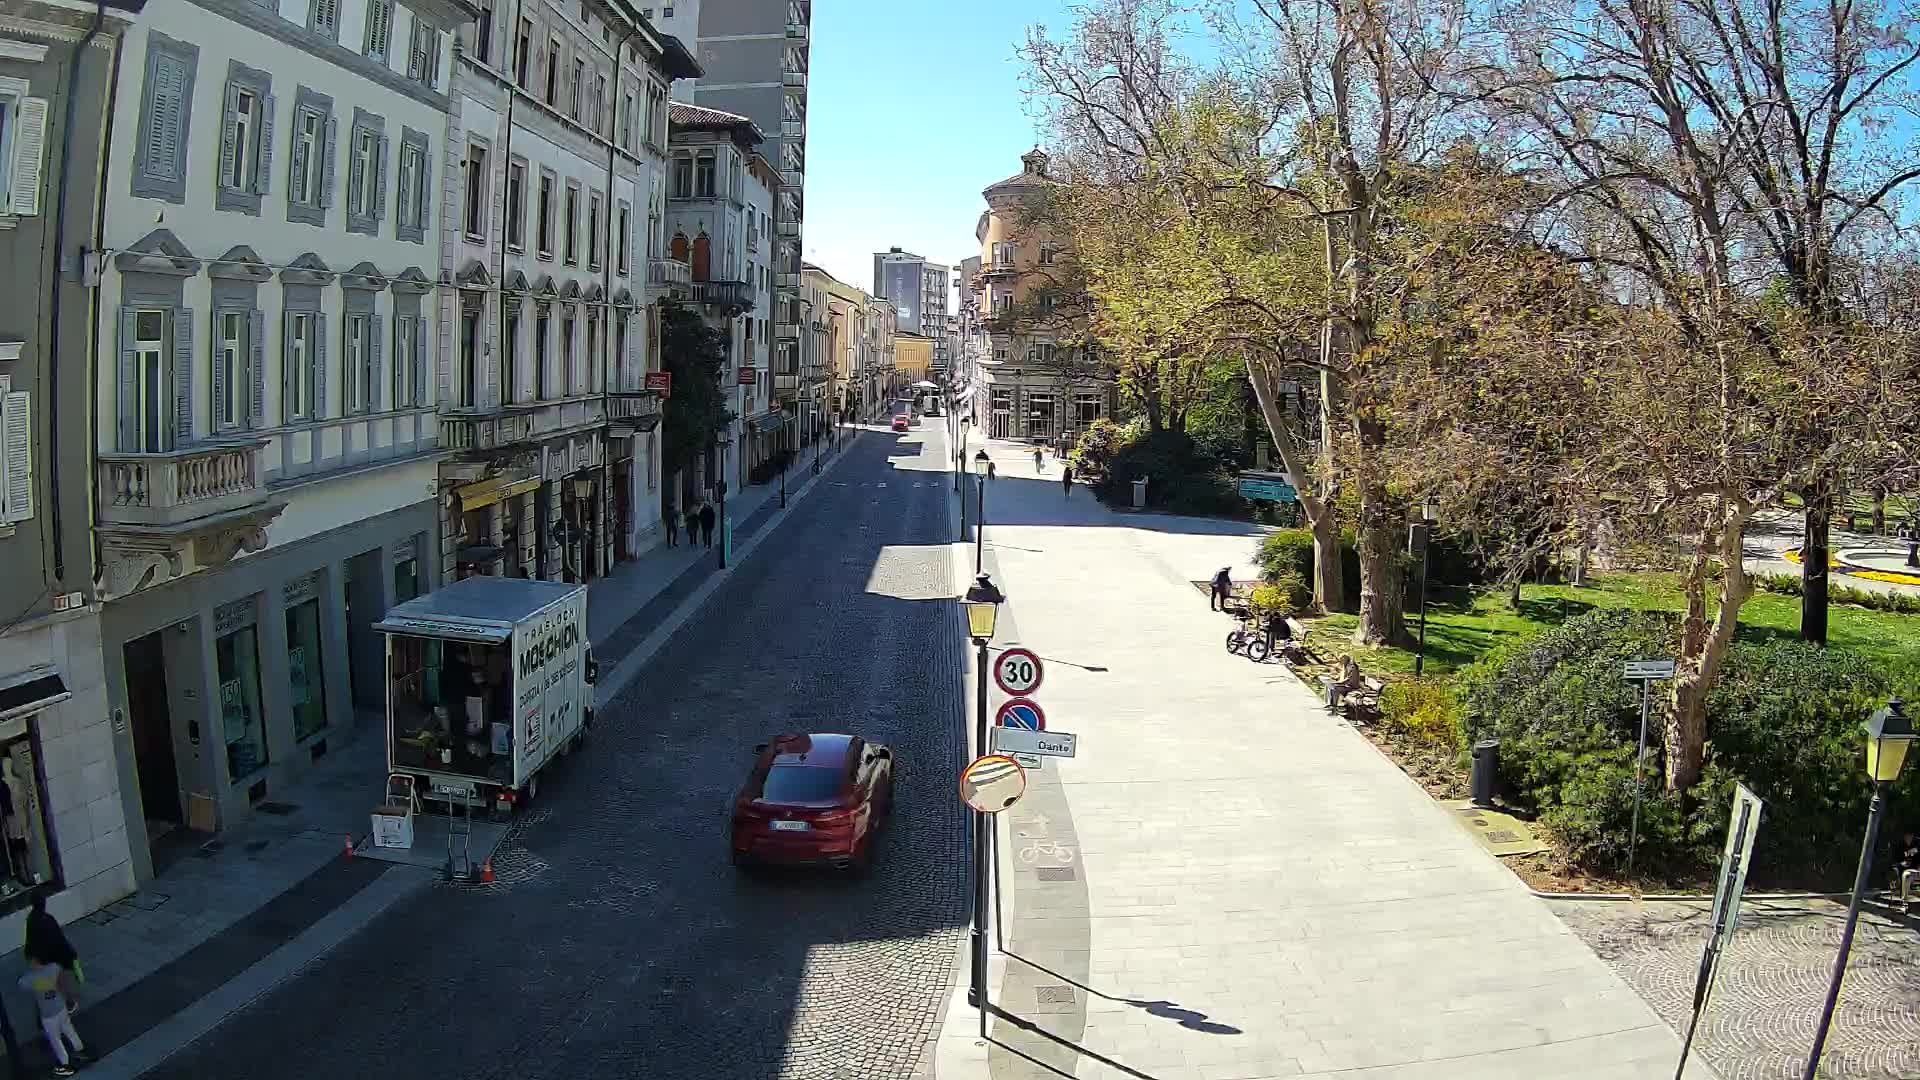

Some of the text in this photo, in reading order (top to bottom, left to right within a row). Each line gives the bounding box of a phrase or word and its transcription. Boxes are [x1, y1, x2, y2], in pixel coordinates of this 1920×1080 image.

[523, 607, 578, 645] TRASLOCHI
[520, 621, 579, 680] MOSCHION
[1005, 661, 1033, 684] 30
[1038, 741, 1070, 753] Dante
